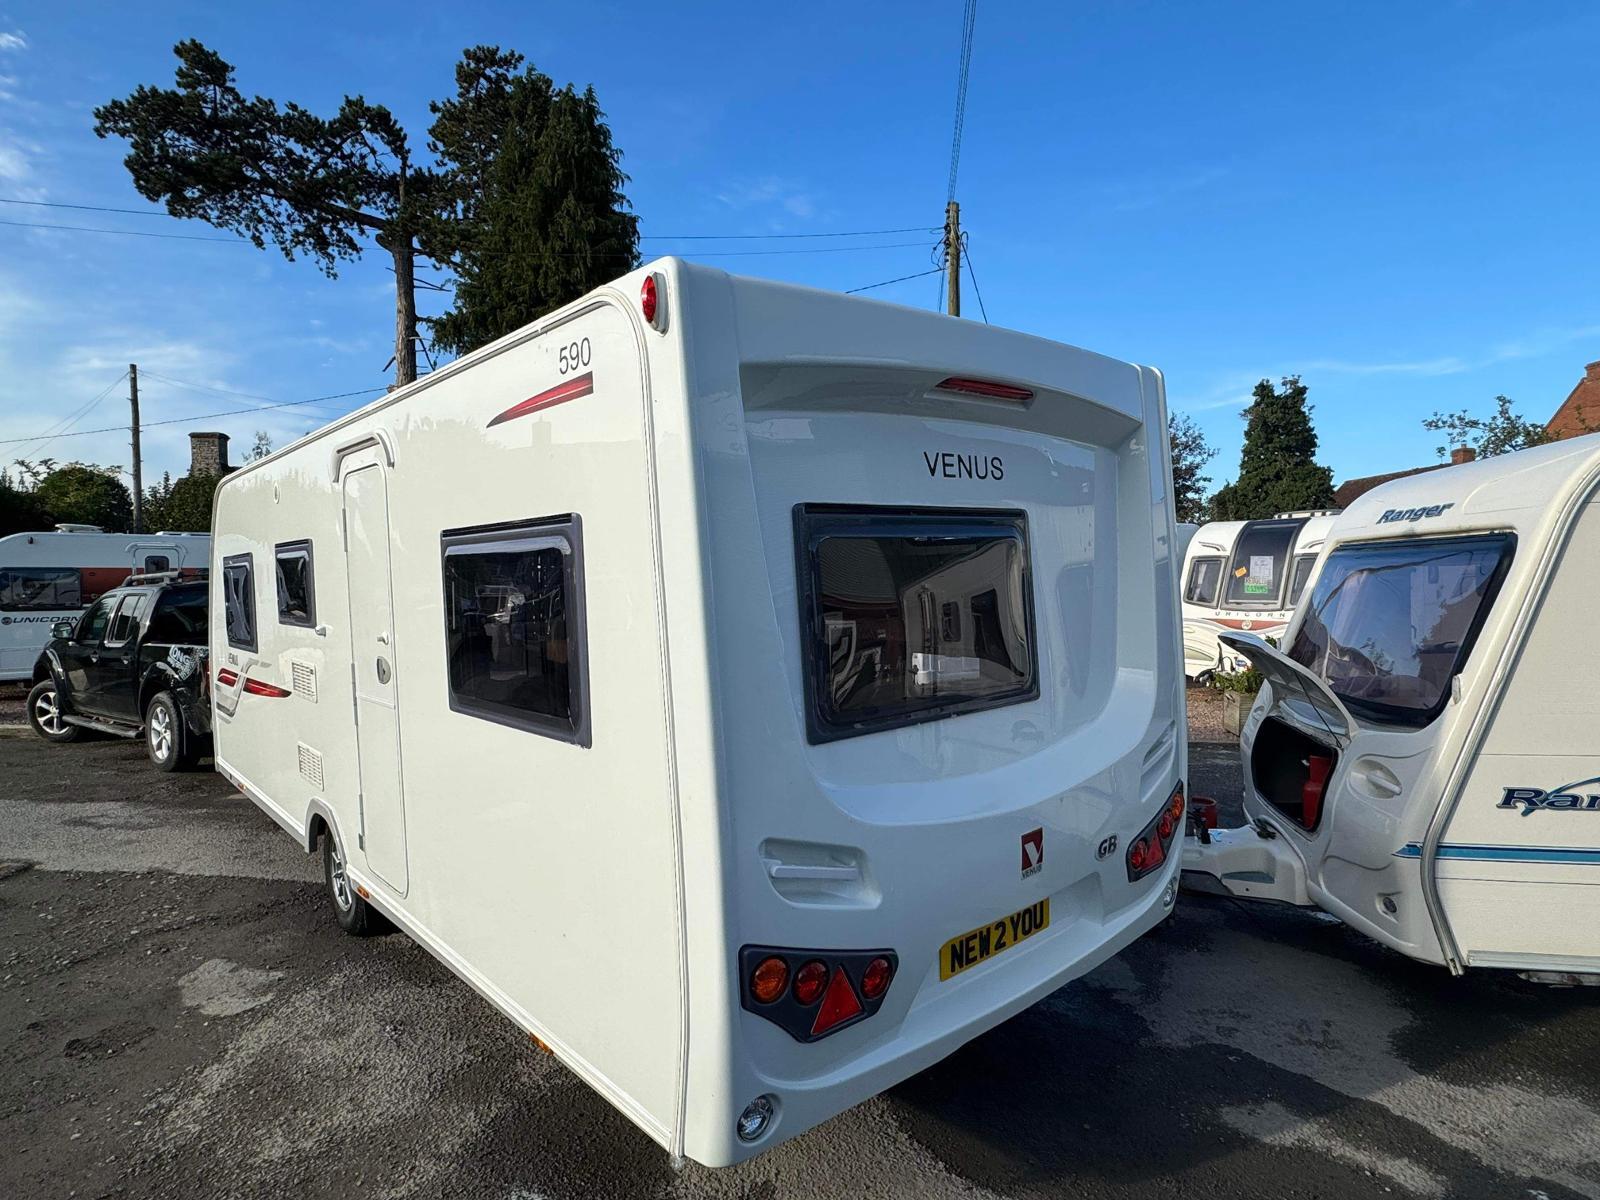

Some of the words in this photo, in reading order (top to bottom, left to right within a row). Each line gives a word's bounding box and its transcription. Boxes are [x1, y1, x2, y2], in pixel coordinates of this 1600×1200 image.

[559, 337, 592, 375] 590
[923, 451, 1004, 480] VENUS
[1375, 502, 1456, 524] Ranger
[13, 615, 81, 624] UNICORN
[1098, 835, 1117, 858] GB
[1020, 864, 1043, 880] VENUS
[951, 929, 990, 973] NEW
[1010, 901, 1044, 942] YOU
